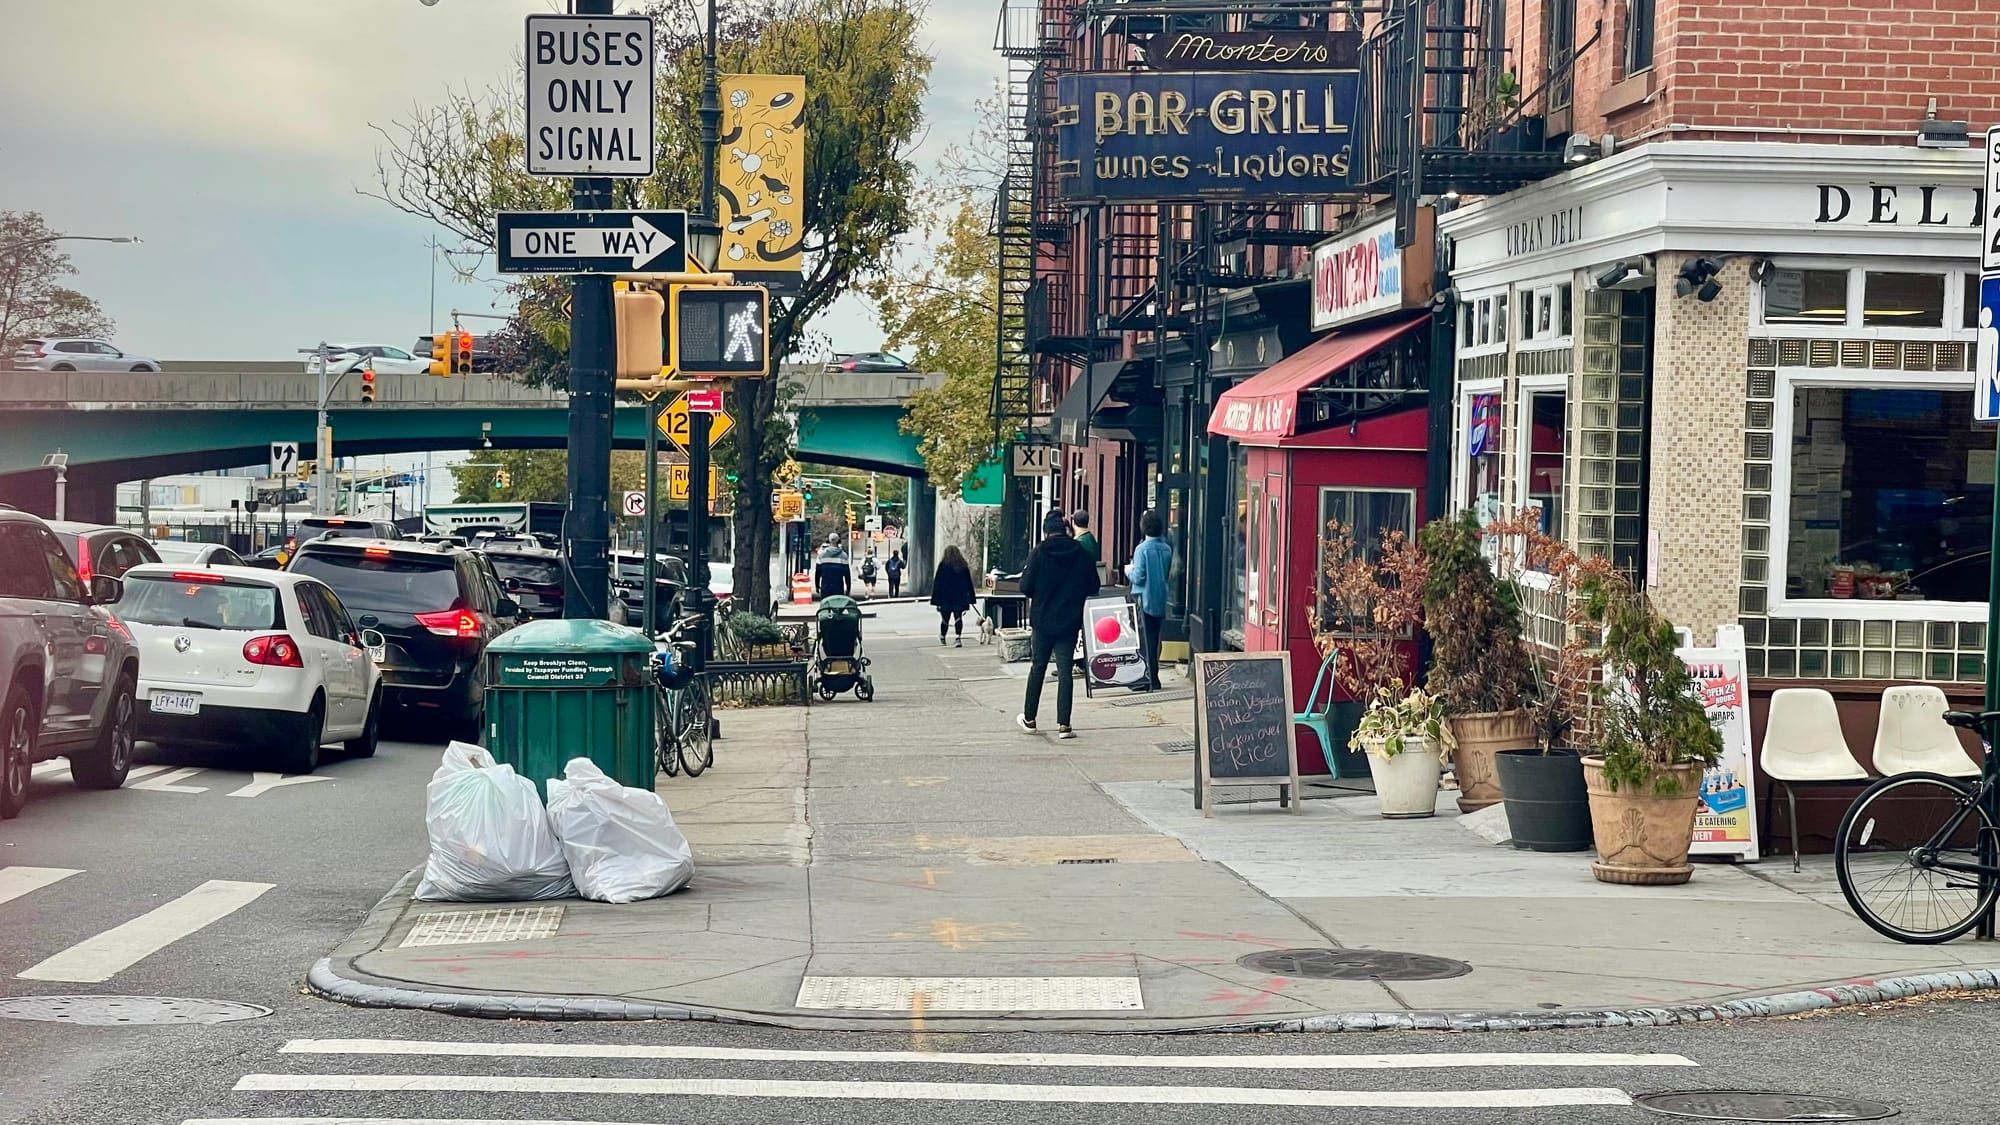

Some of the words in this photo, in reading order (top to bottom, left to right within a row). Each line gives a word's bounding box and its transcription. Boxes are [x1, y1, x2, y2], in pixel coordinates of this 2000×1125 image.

[537, 32, 643, 66] BUSES
[1166, 33, 1328, 62] Montero
[549, 79, 633, 114] ONLY
[539, 126, 642, 161] SIGNAL
[525, 231, 577, 255] ONE
[602, 231, 657, 255] WAY
[1507, 216, 1543, 257] URBAN
[1552, 206, 1582, 246] DELI
[1316, 237, 1378, 313] MONTERO
[1022, 450, 1044, 466] XI
[1686, 664, 1724, 678] DELI
[1707, 686, 1724, 697] OPEN
[1725, 683, 1736, 693] 24
[1715, 694, 1736, 705] HOURS
[1218, 710, 1255, 730] Plate
[1711, 711, 1735, 721] WRAPS
[1230, 743, 1278, 770] Rice
[1705, 817, 1737, 826] CATERING
